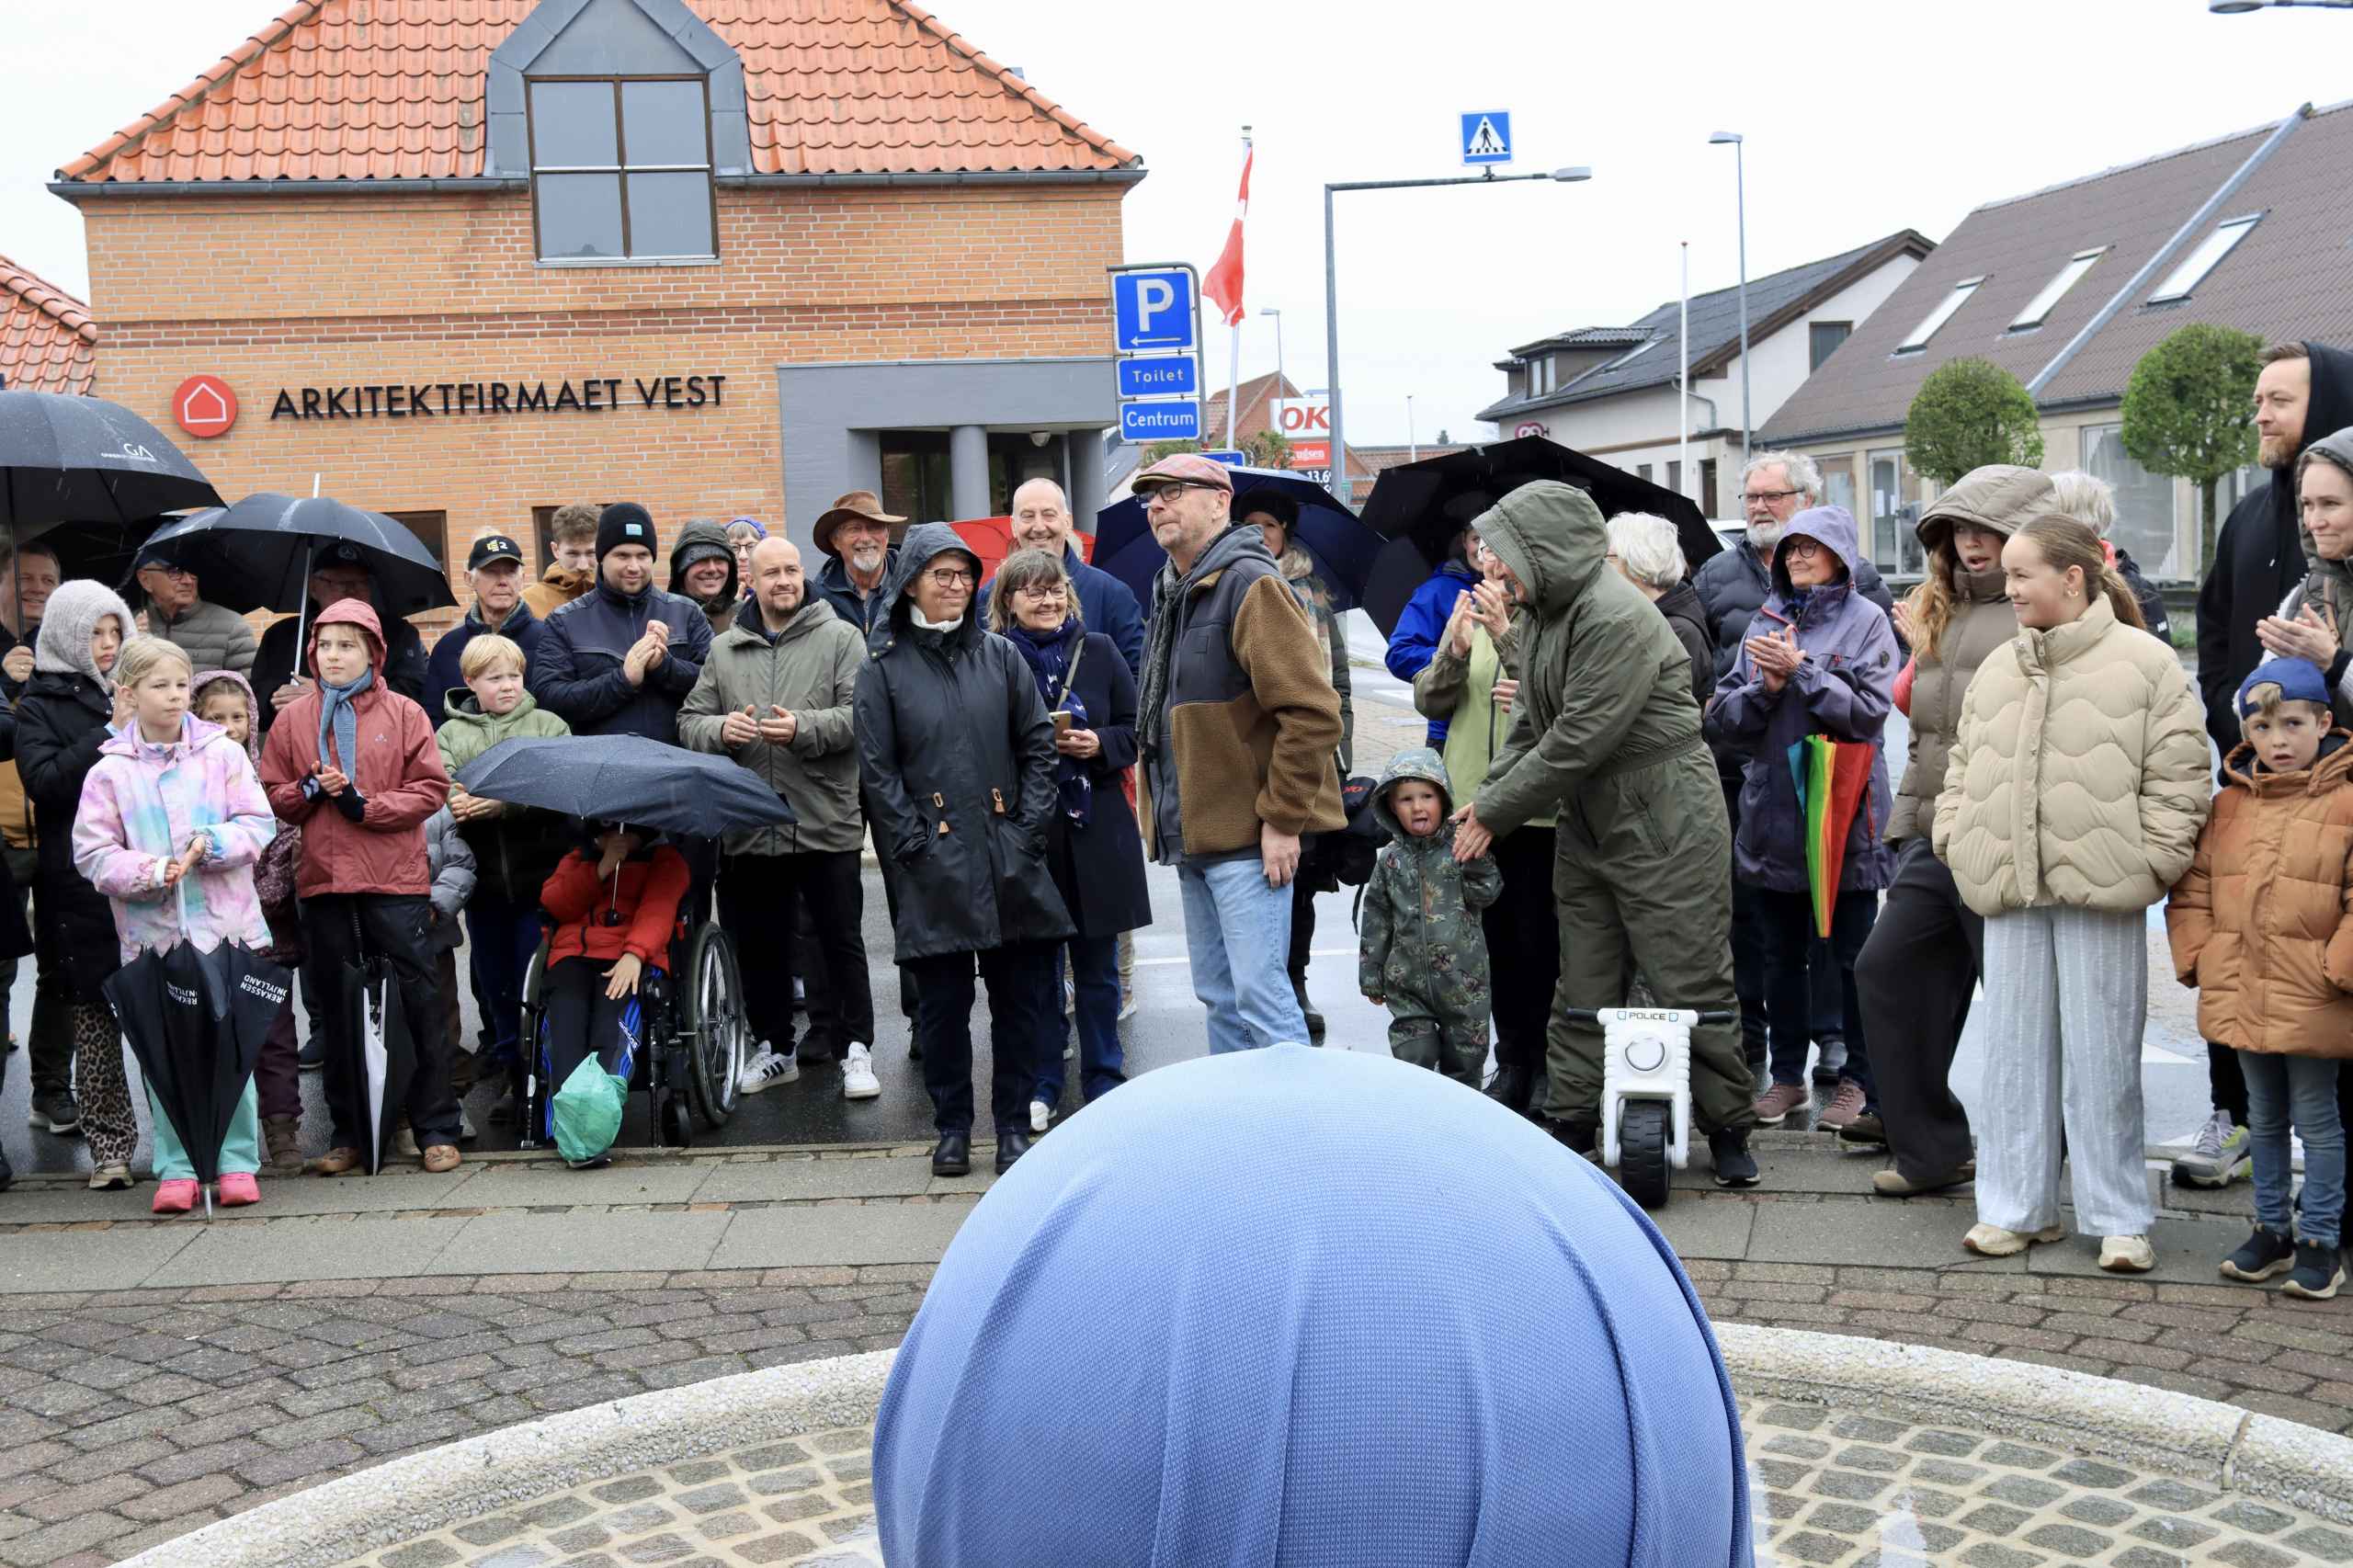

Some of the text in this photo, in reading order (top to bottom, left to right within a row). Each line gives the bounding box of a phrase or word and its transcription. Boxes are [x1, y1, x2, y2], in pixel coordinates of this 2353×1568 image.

[1137, 278, 1174, 332] P
[1132, 369, 1184, 382] Toilet
[270, 375, 726, 419] ARKITEKTFIRMAET VEST
[1126, 411, 1194, 426] Centrum
[1279, 406, 1330, 430] OK
[240, 981, 285, 1004] REKASSEN
[1629, 1012, 1666, 1020] POLICE
